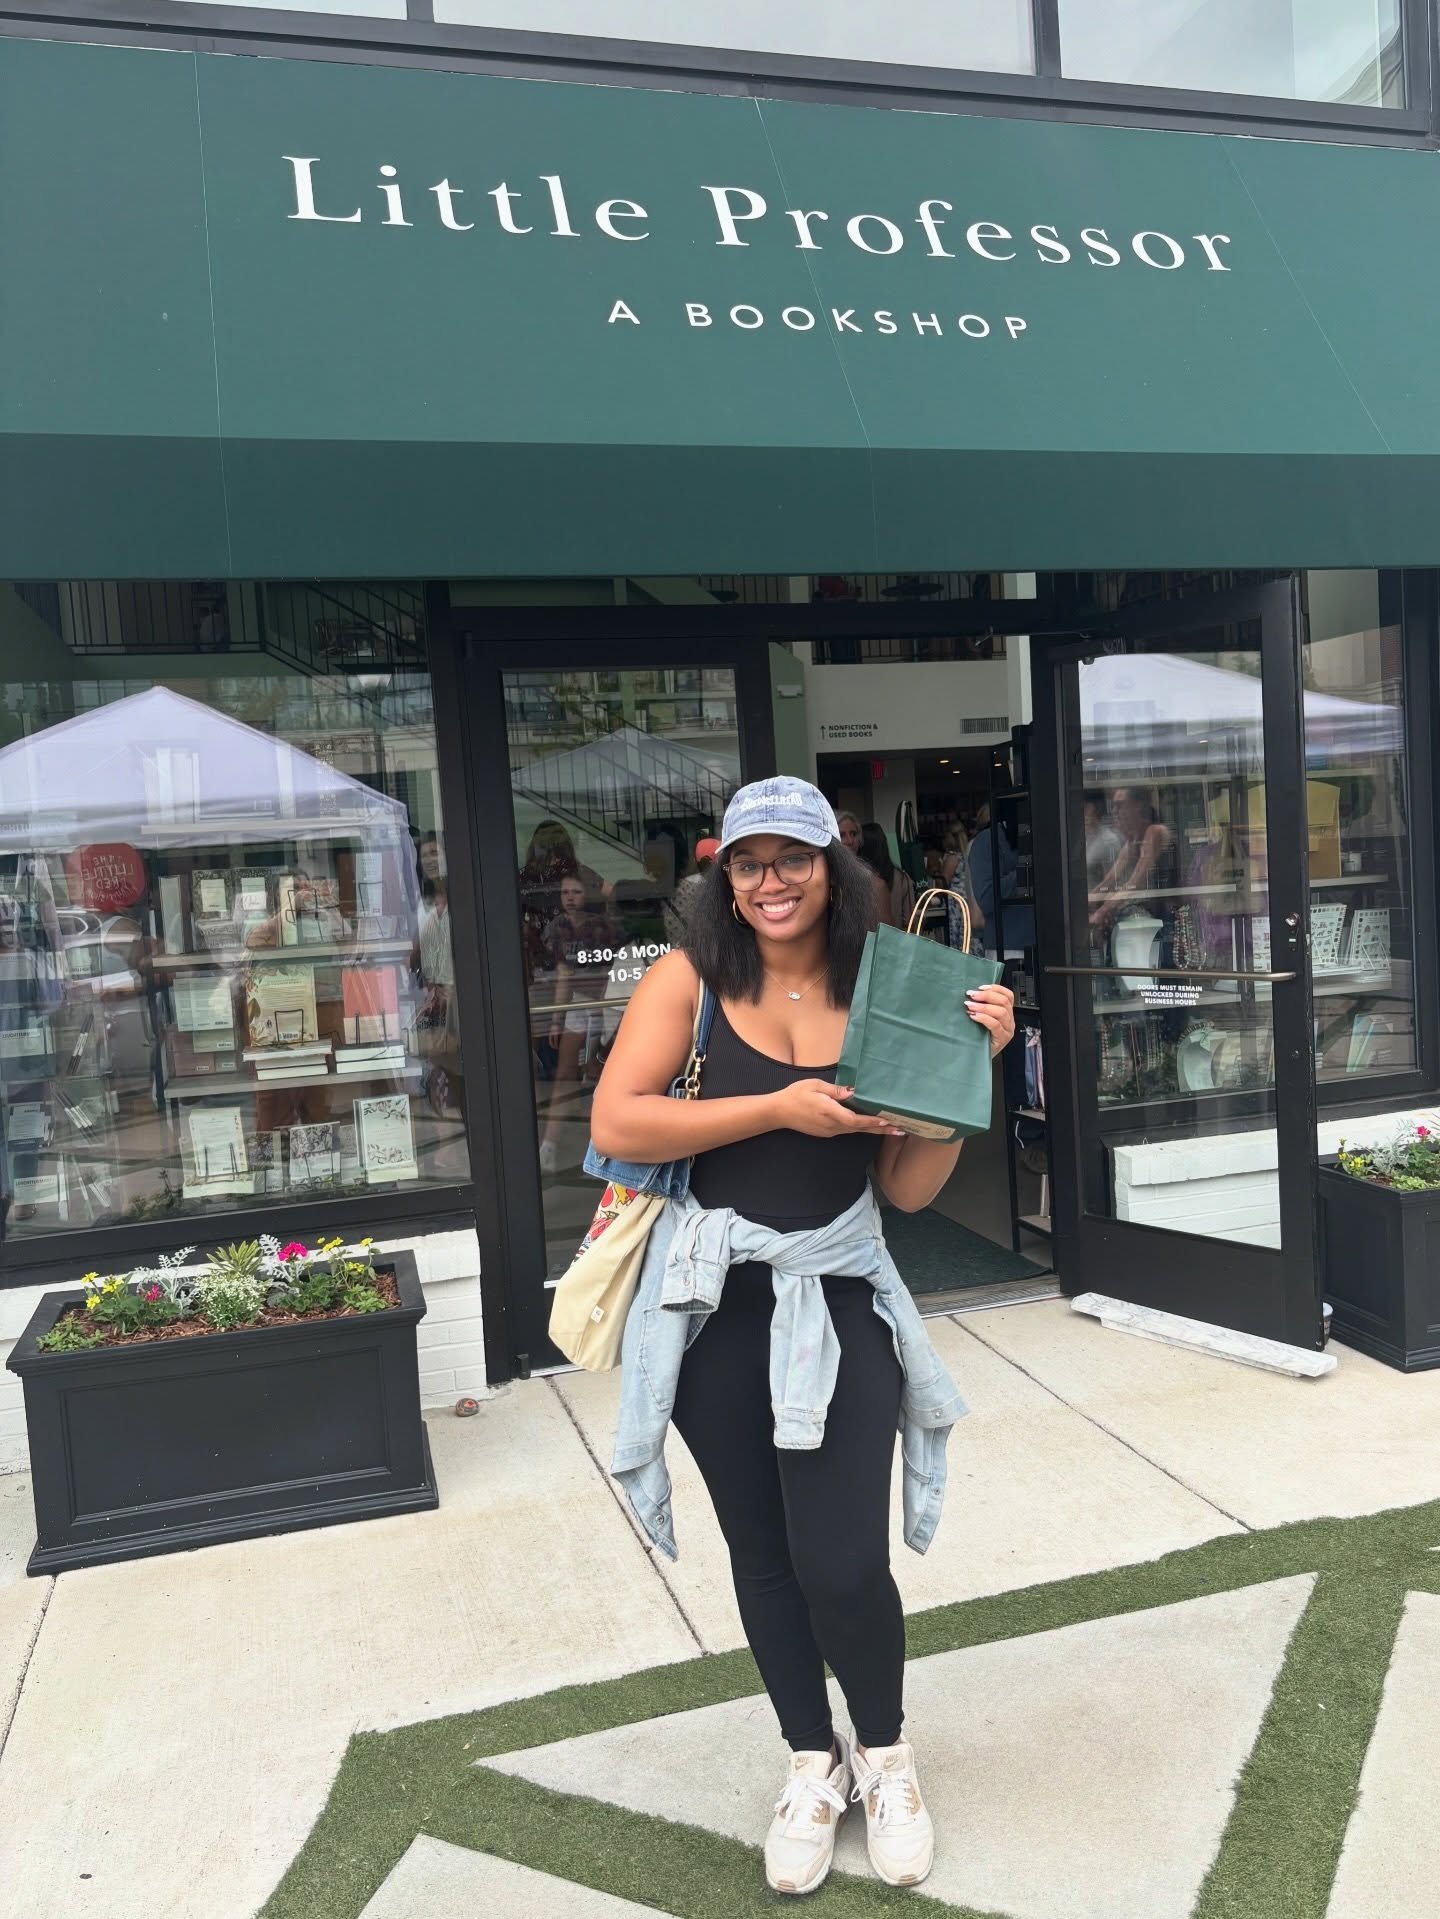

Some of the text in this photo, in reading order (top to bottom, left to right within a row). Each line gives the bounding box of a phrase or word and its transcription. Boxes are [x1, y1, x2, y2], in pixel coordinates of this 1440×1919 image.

[282, 156, 1231, 271] Little Professor
[608, 300, 1028, 339] A BOOKSHOP
[577, 947, 628, 964] 8:30-6
[608, 967, 642, 982] 10-5
